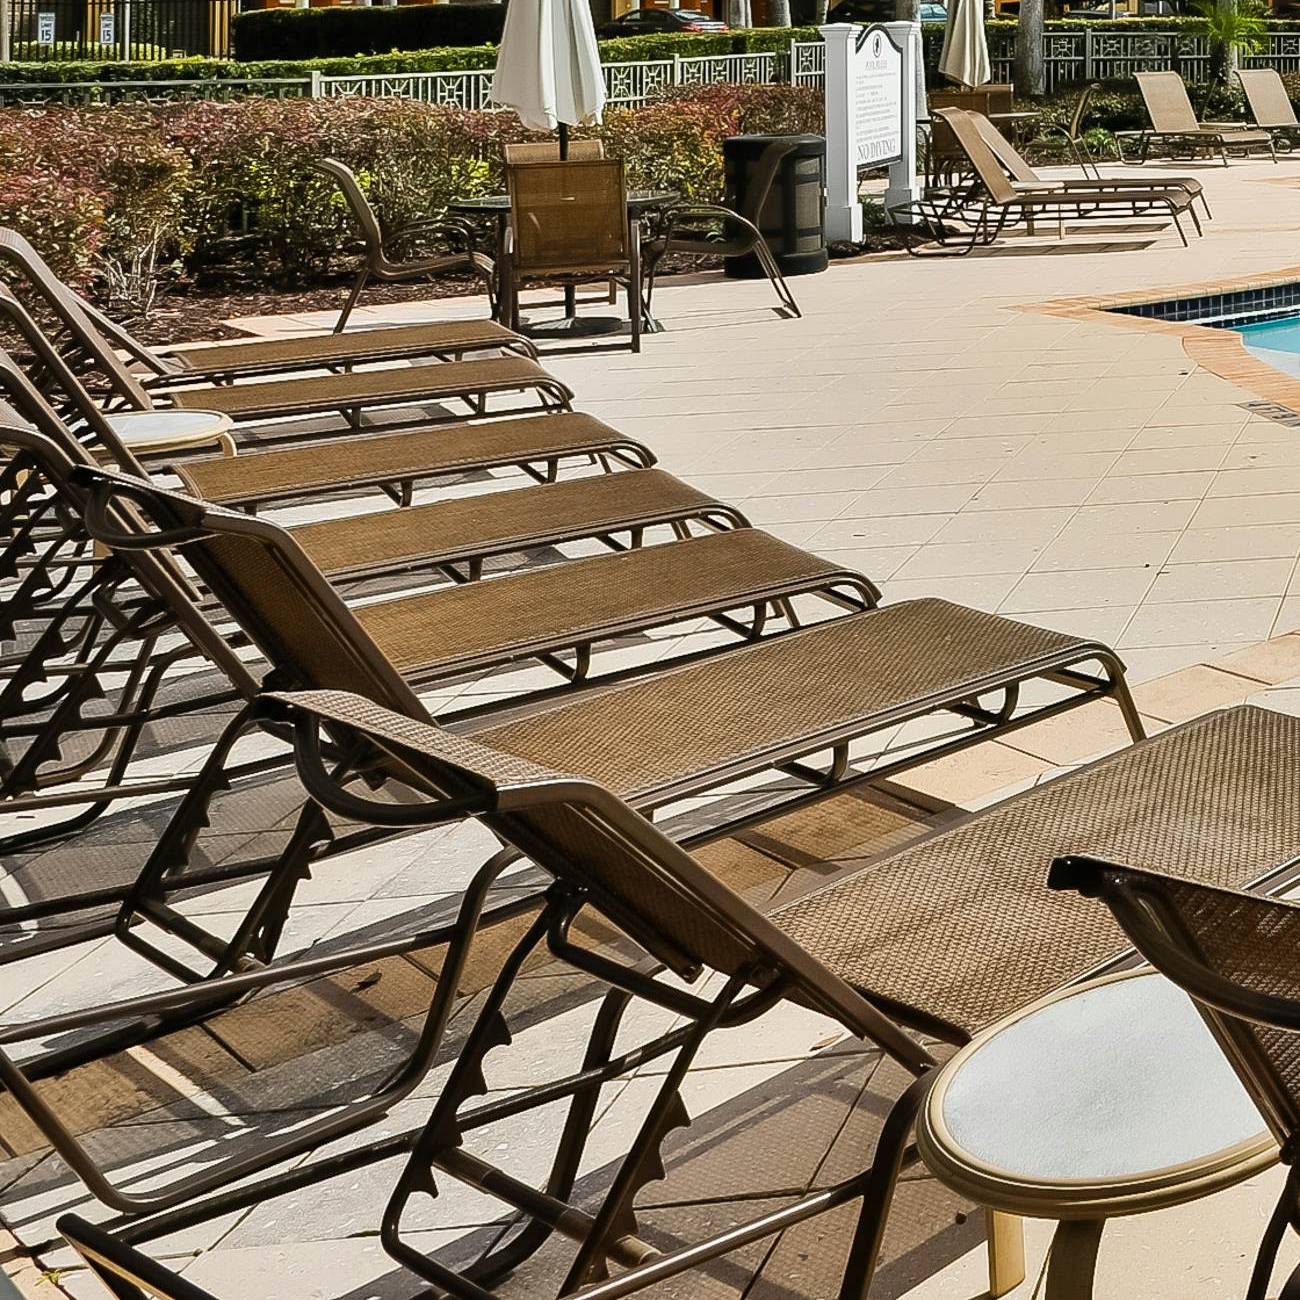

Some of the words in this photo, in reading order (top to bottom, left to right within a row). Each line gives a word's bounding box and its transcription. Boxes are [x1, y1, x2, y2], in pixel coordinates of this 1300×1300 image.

[41, 29, 52, 41] 15
[102, 29, 112, 42] 15
[857, 143, 870, 161] NO
[870, 138, 896, 158] DIVING
